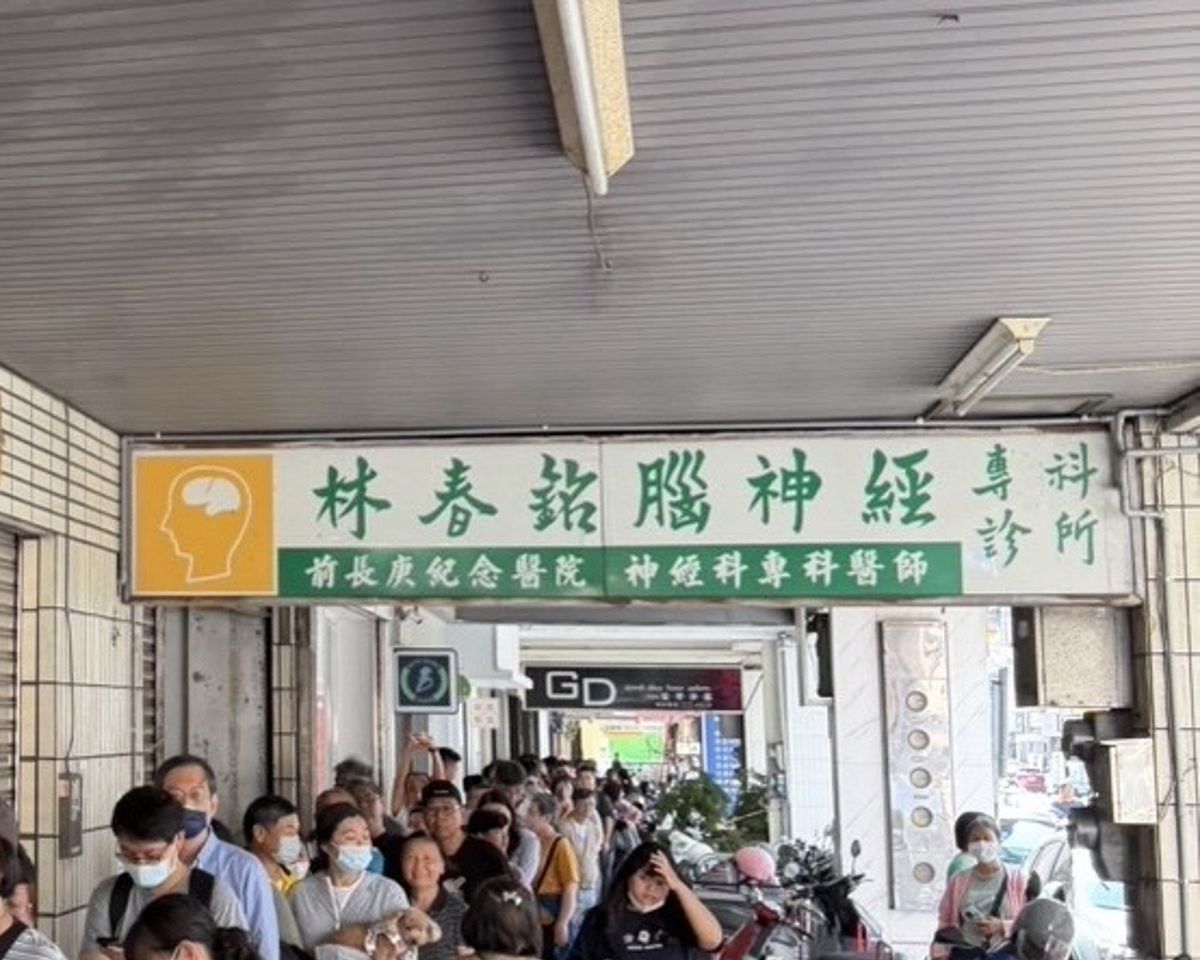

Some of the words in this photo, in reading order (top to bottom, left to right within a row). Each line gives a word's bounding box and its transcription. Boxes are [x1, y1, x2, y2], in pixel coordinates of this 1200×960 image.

[313, 449, 937, 540] 林春銘腦神經
[304, 554, 587, 590] 前長庚紀念醫院
[624, 549, 928, 589] 神經科專科醫師
[546, 671, 616, 706] GD
